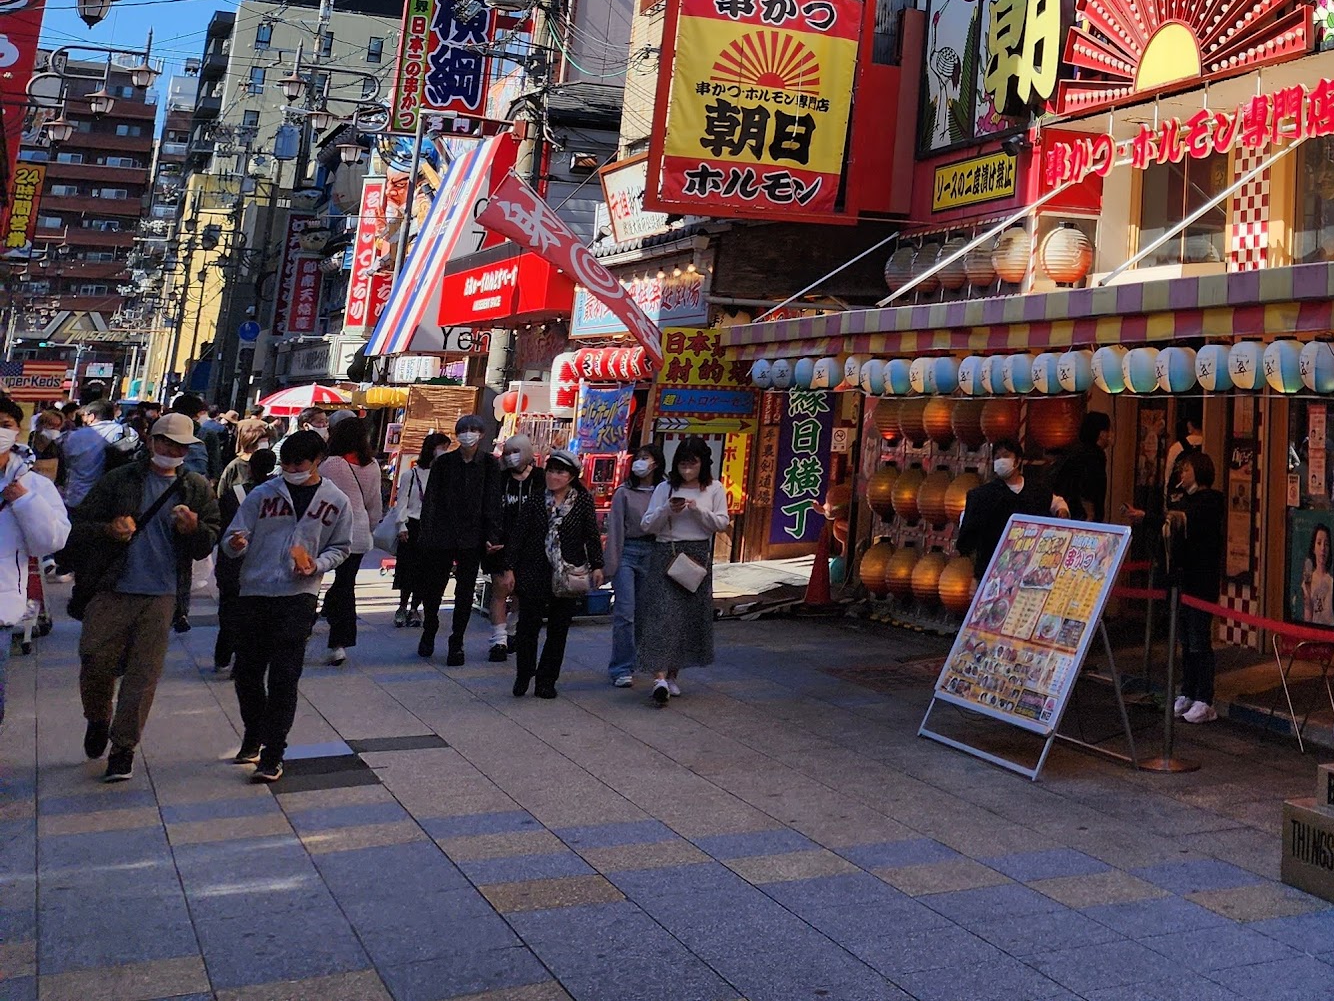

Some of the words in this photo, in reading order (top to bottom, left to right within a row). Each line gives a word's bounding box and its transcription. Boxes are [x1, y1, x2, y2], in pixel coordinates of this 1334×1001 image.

[700, 98, 817, 166] 朝日
[683, 162, 823, 206] ホルモン
[441, 327, 492, 350] Yen
[780, 384, 830, 539] 縁日横丁
[1064, 548, 1096, 570] 串かつ
